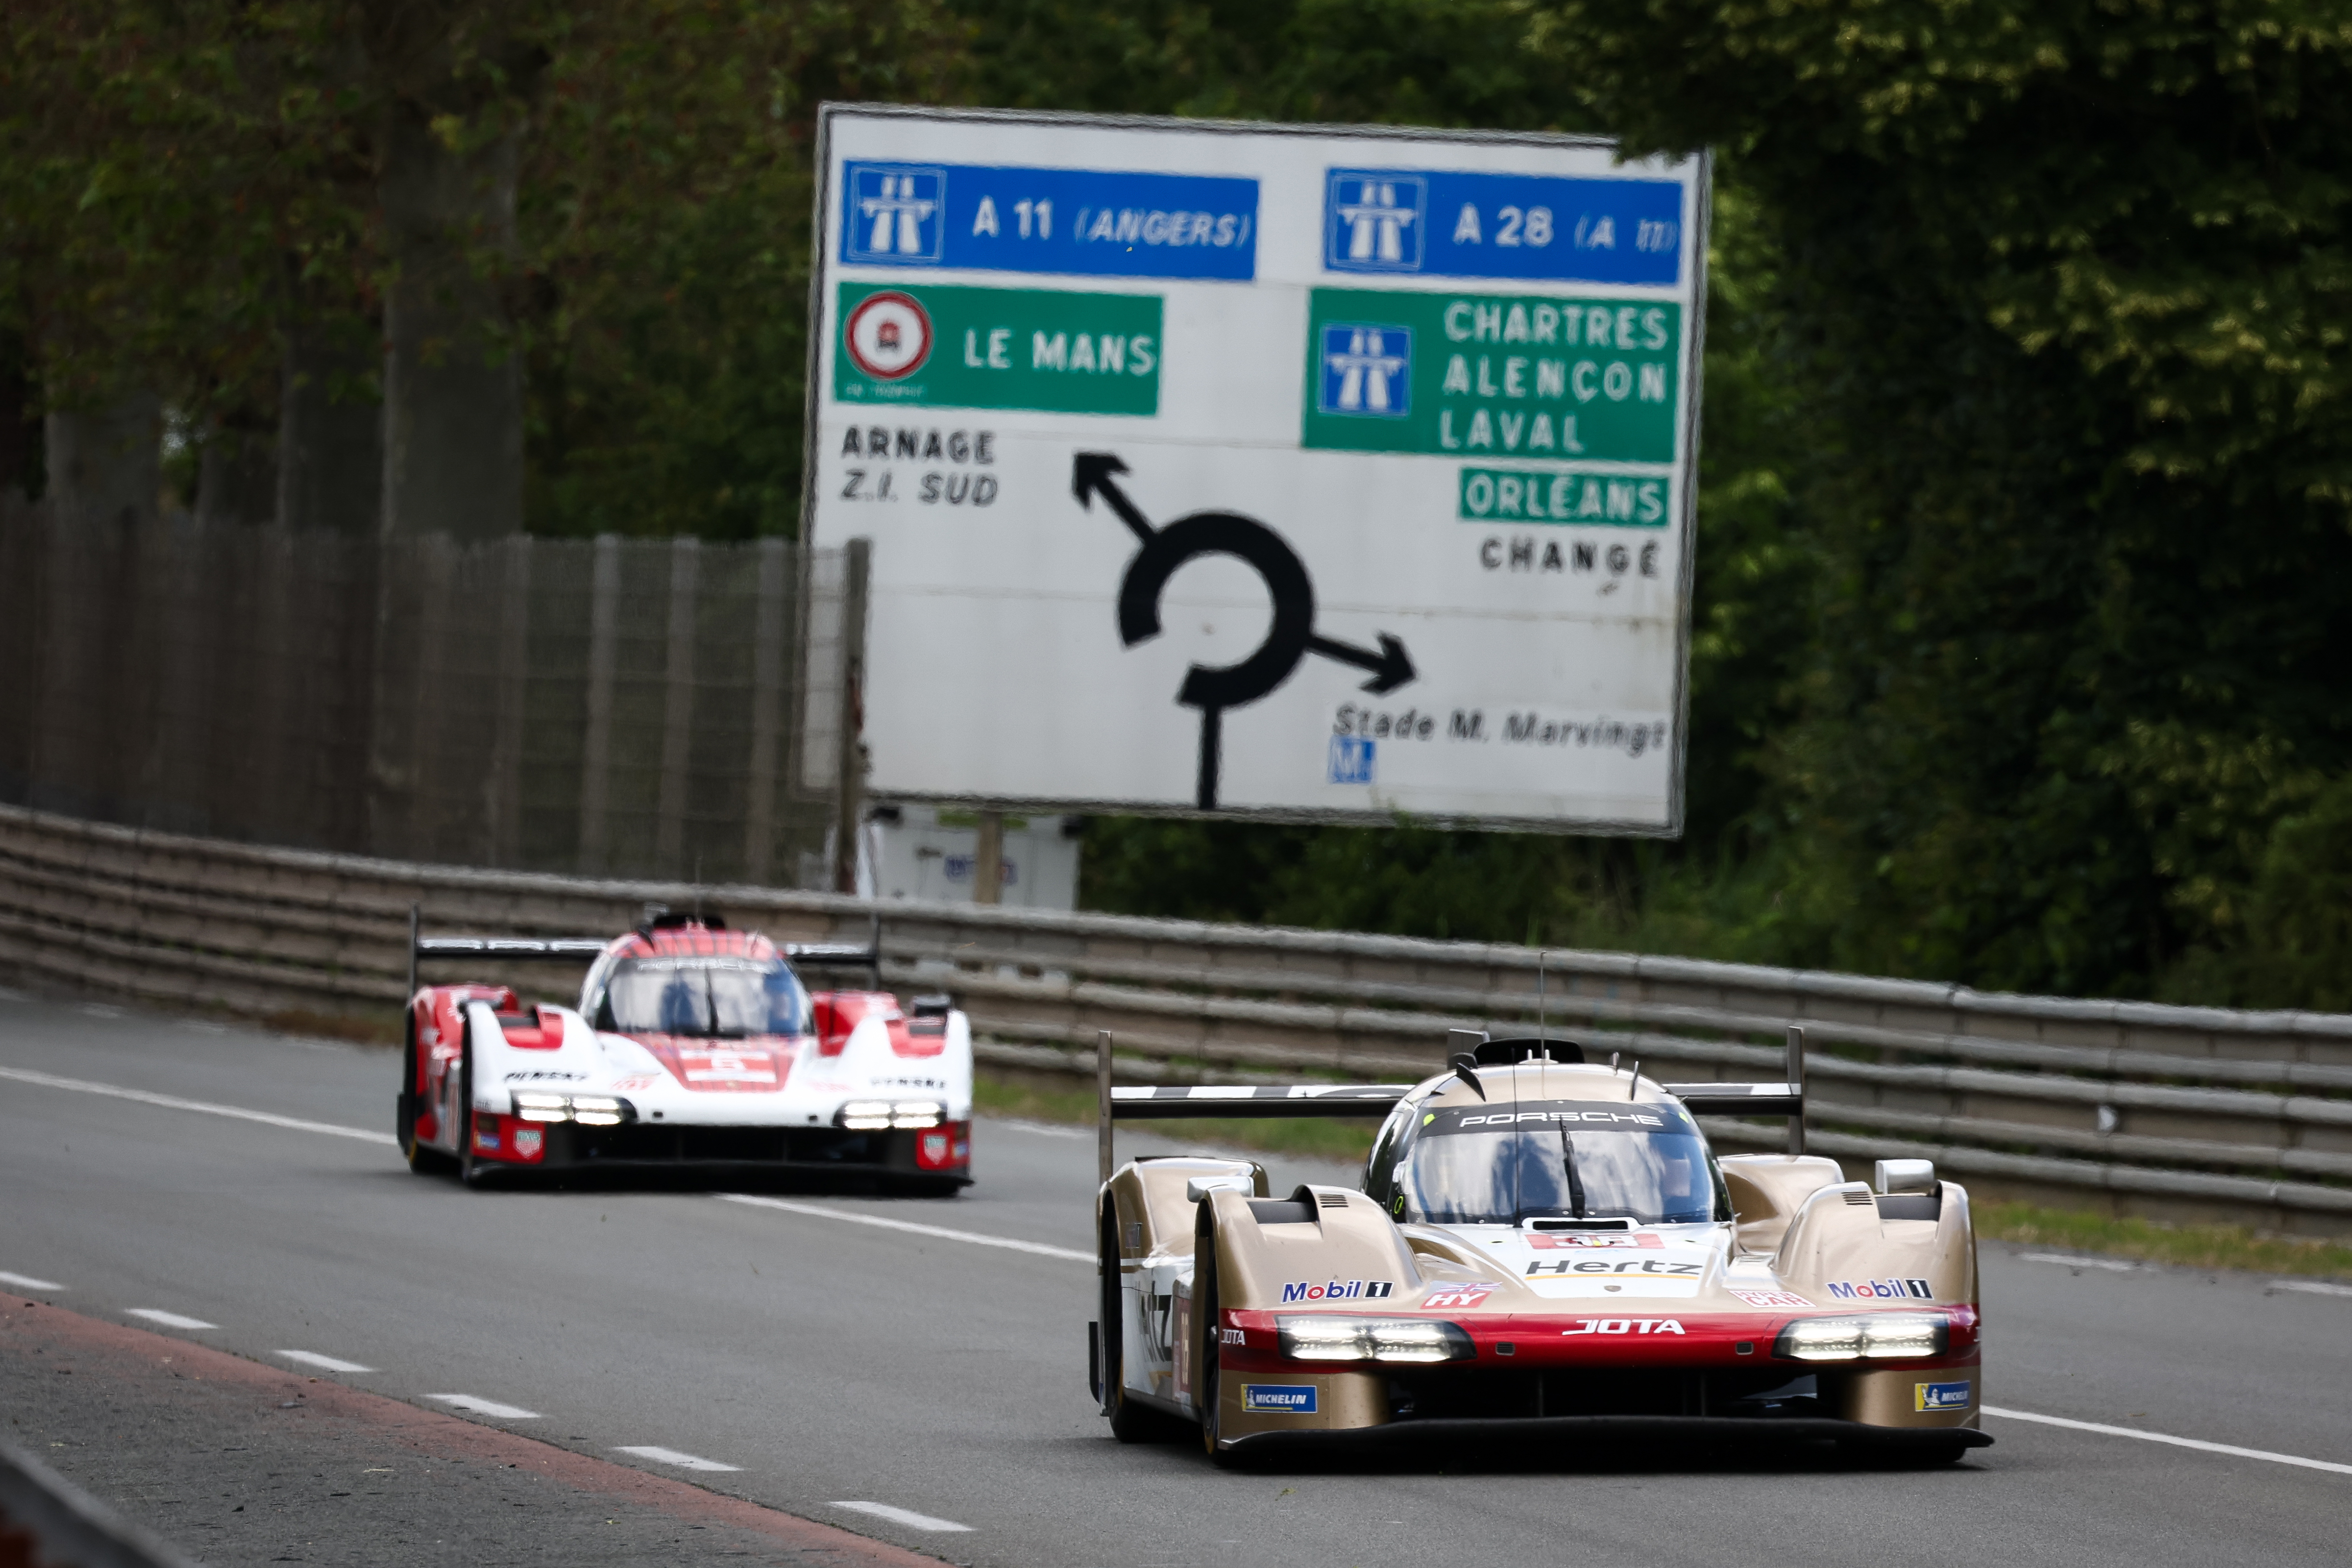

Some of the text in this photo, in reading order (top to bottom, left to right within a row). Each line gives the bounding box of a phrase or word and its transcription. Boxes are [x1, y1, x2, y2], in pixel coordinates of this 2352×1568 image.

[973, 194, 1251, 248] A 11 (ANGERS)
[1453, 202, 1482, 245] A
[1495, 205, 1554, 248] 28
[1444, 300, 1669, 351] CHARTRES
[963, 328, 1157, 377] LE MANS
[1442, 353, 1668, 404] ALENÇON
[841, 425, 996, 464] ARNAGE
[1441, 408, 1586, 454] LAVAL
[841, 468, 998, 507] Z.I. SUD
[1332, 702, 1436, 742] Stade
[1447, 708, 1489, 743] M.
[1460, 1112, 1664, 1128] PORSCHE
[1526, 1260, 1704, 1275] Hertz
[1283, 1281, 1361, 1303] Mobil
[1425, 1293, 1487, 1307] HY
[1746, 1297, 1811, 1306] CAR
[1828, 1279, 1906, 1298] Mobil
[1562, 1319, 1686, 1336] JOTA
[1255, 1394, 1307, 1404] MICHELIN
